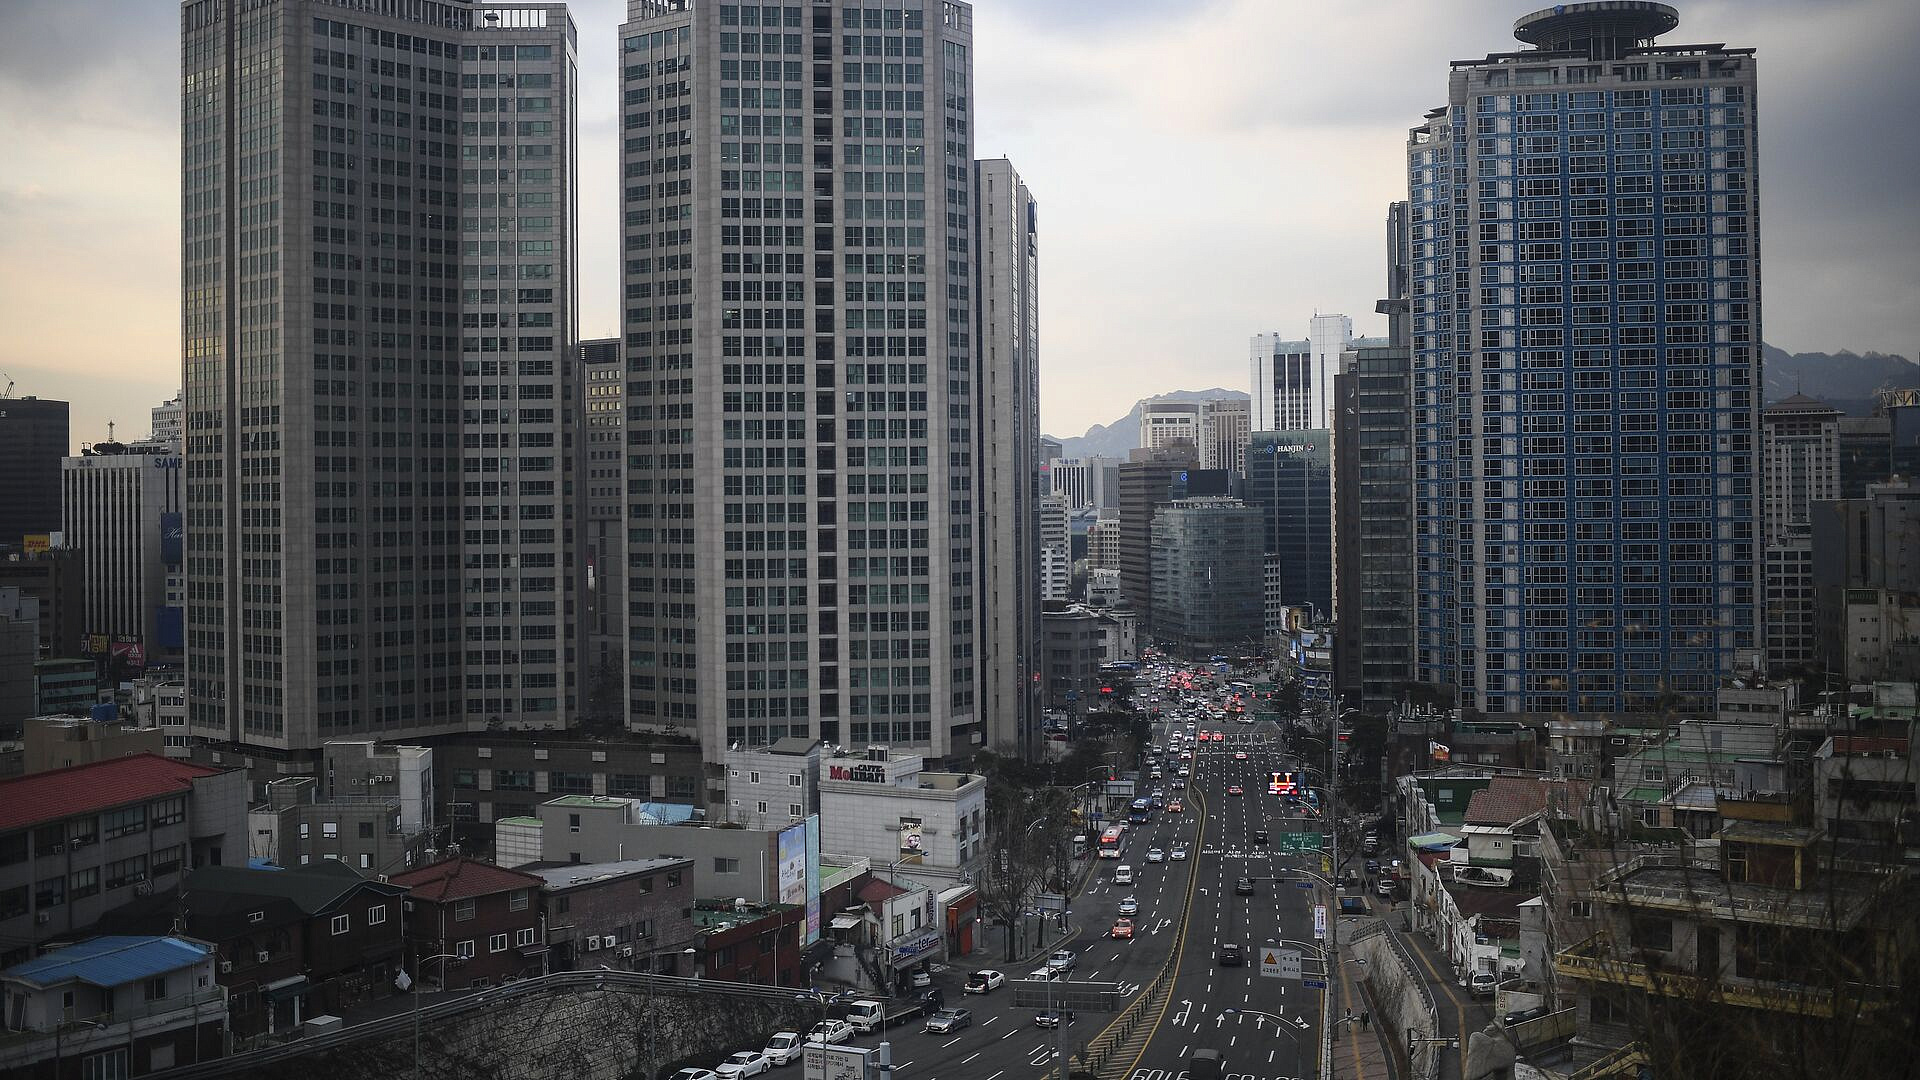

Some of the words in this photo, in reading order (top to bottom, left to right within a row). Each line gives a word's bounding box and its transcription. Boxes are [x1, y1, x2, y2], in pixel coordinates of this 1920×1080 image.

[1277, 445, 1304, 453] HANJIN
[858, 764, 882, 773] CAFFE
[829, 765, 886, 783] Molinari
